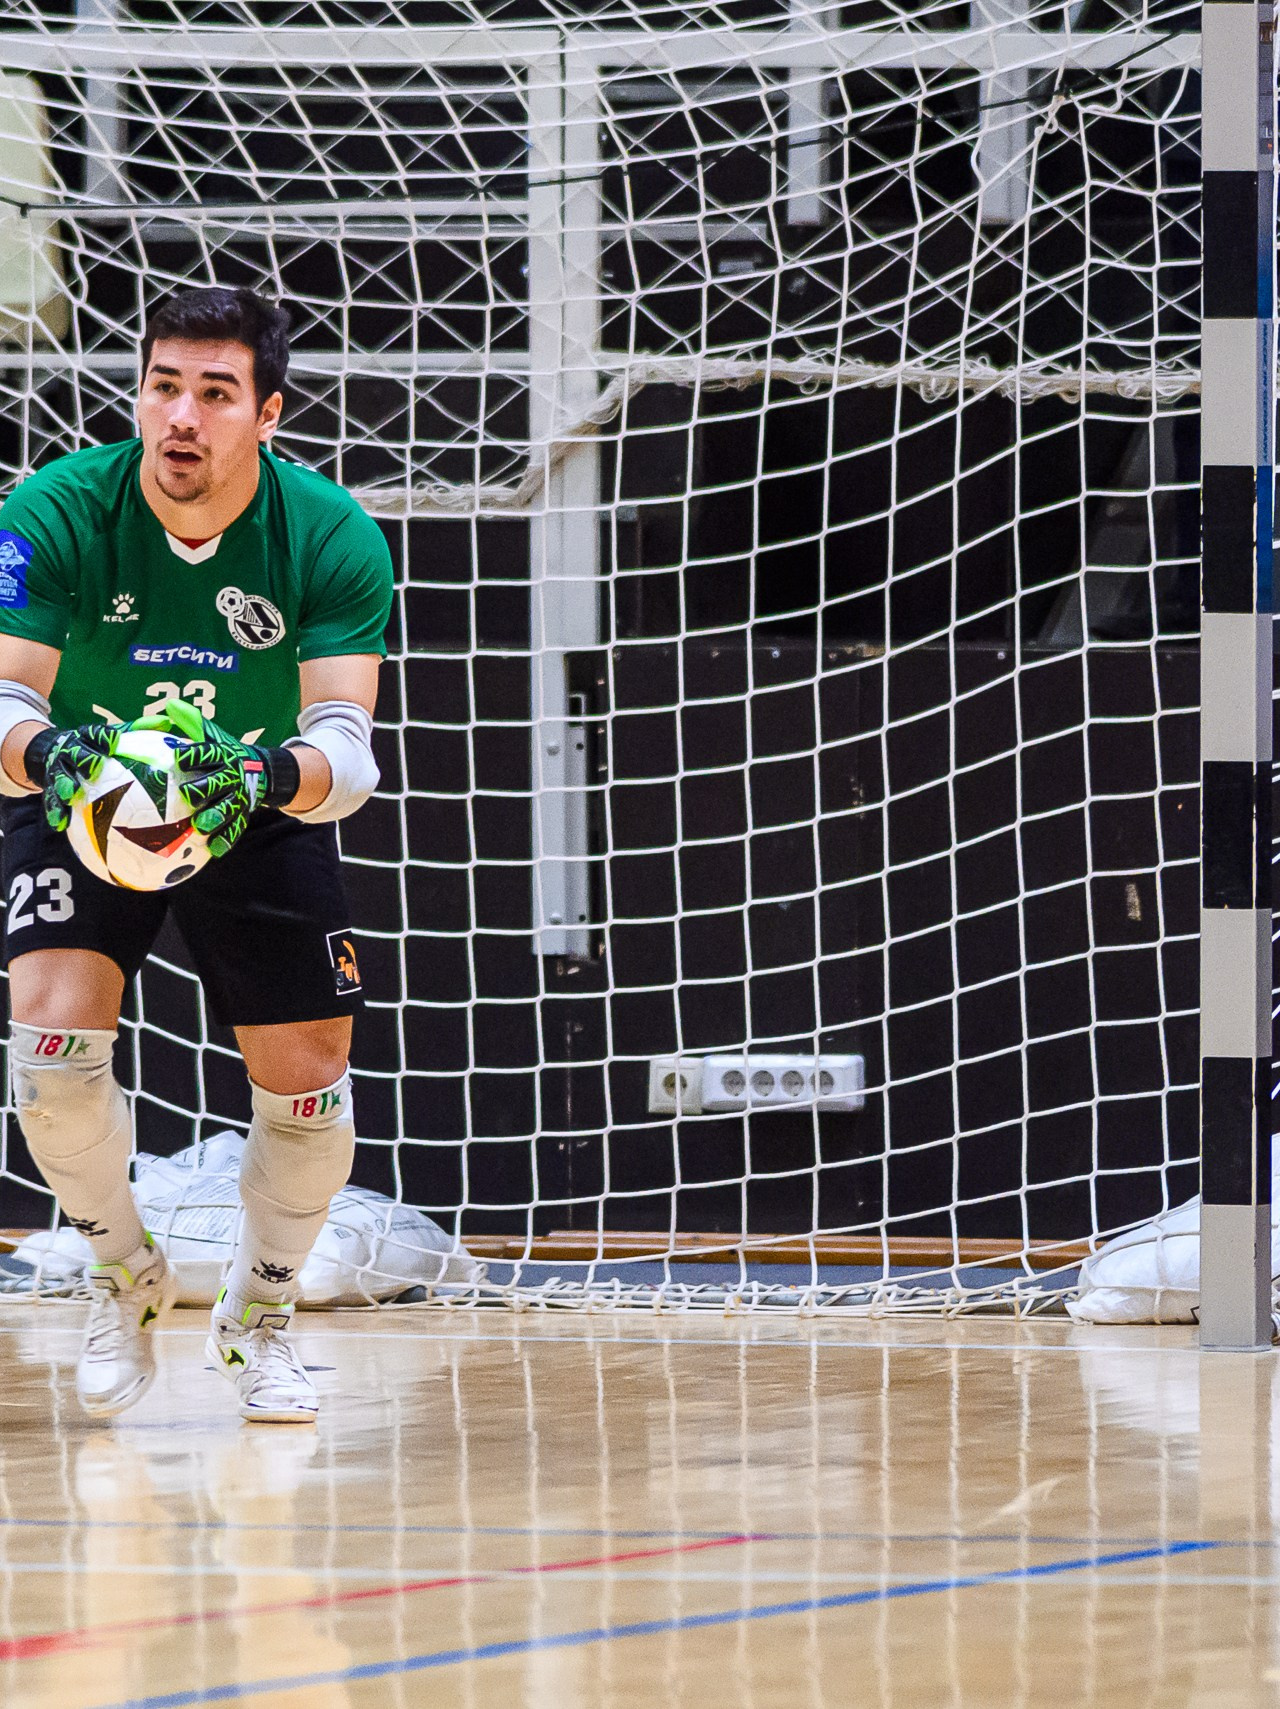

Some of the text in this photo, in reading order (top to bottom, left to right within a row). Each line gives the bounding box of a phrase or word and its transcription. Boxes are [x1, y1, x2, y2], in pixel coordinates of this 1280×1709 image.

[133, 646, 234, 669] БЕТСИТИ
[143, 679, 216, 724] 23
[7, 868, 75, 935] 23
